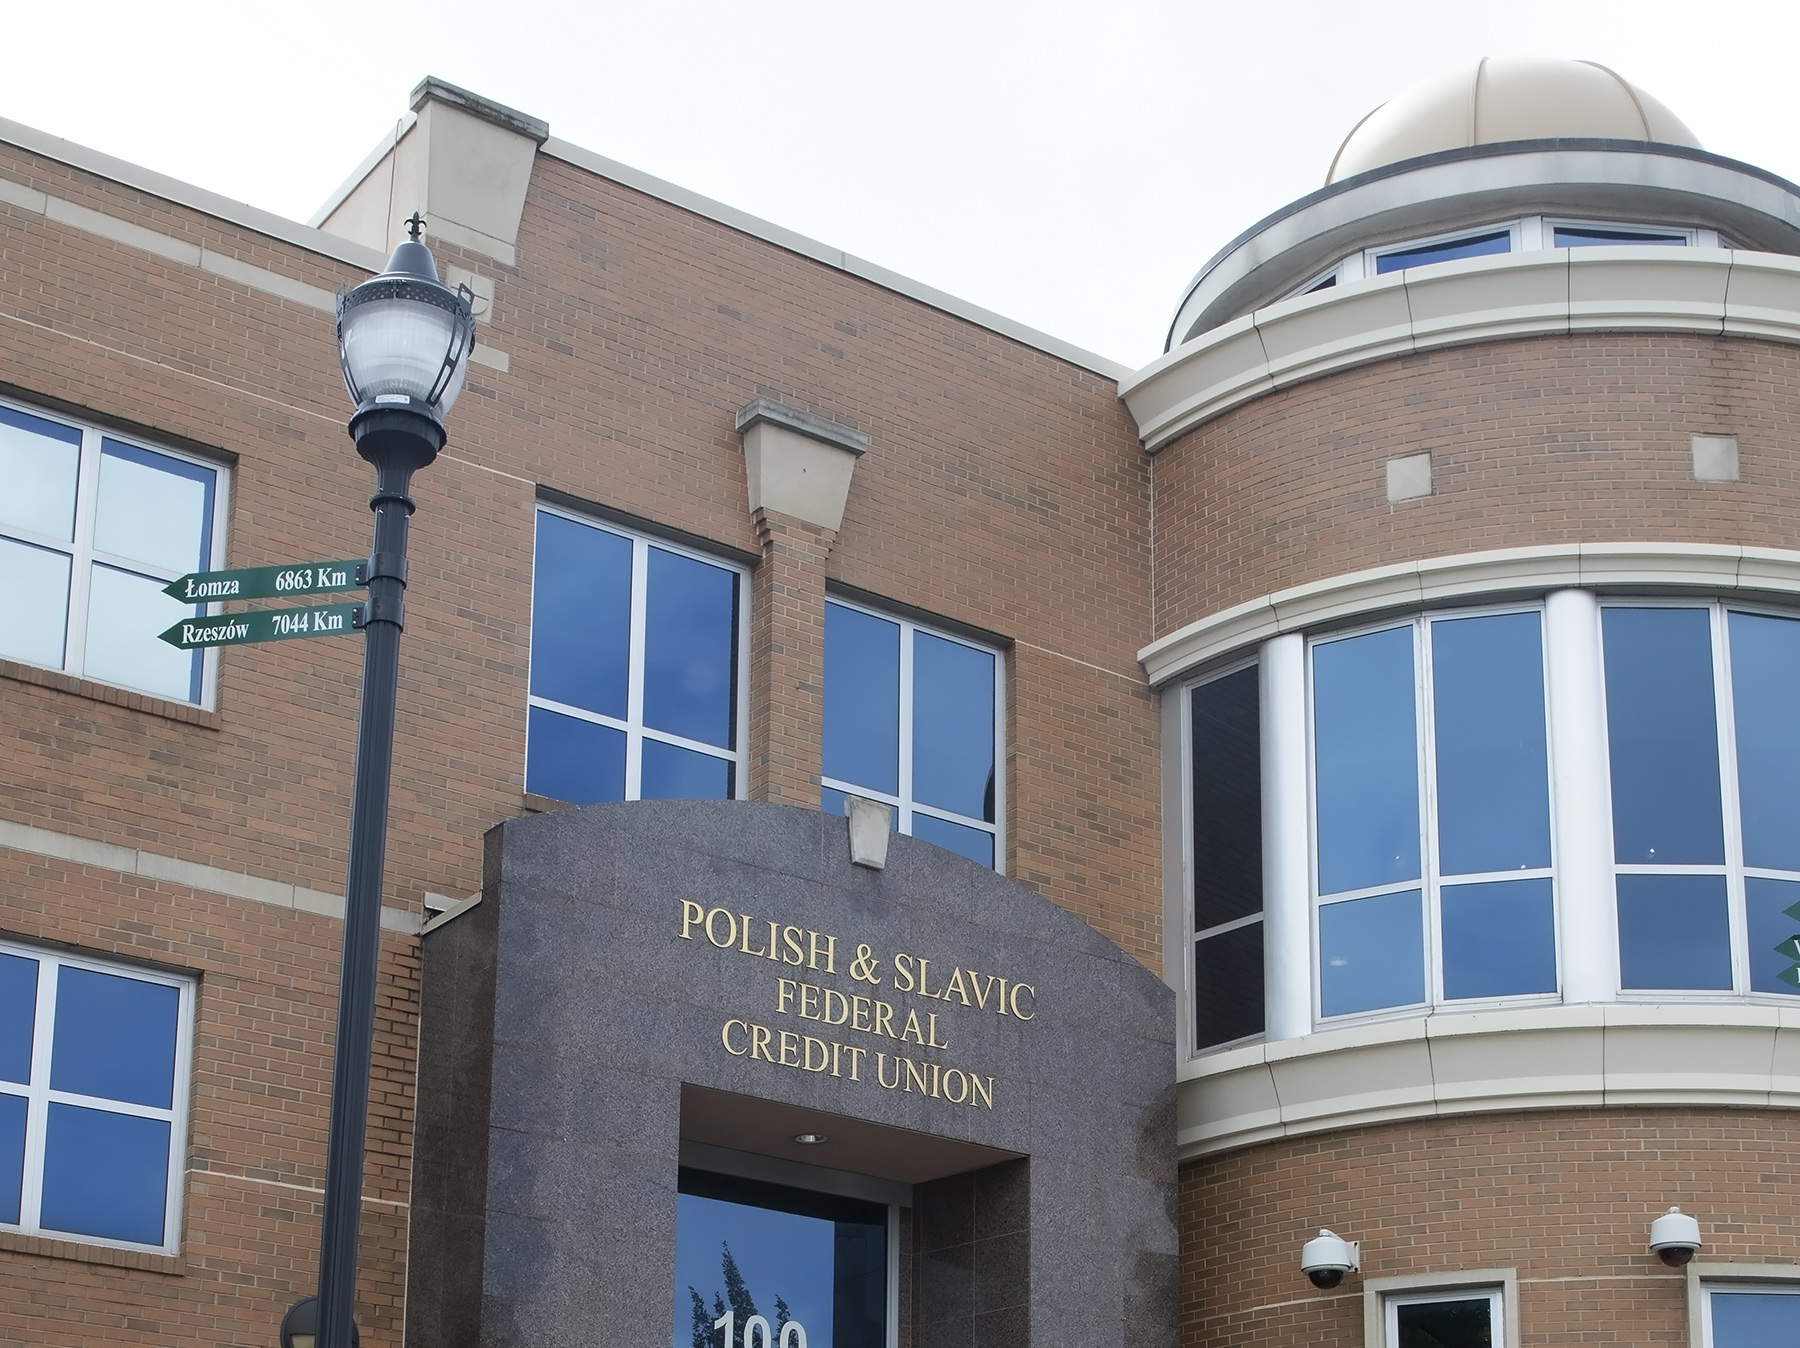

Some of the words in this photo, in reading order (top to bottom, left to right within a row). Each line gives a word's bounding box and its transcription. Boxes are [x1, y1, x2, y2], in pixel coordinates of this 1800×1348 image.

[185, 578, 240, 598] Łomza
[275, 568, 313, 591] 6863
[316, 567, 347, 588] Km
[181, 619, 250, 644] Rzeszów
[271, 613, 309, 635] 7044
[313, 610, 344, 632] Km
[678, 899, 838, 975] POLISH
[849, 943, 882, 985] &
[894, 952, 1036, 1021] SLAVIC
[775, 977, 949, 1050] FEDERAL
[721, 1019, 867, 1082] CREDIT
[875, 1051, 995, 1111] UNION
